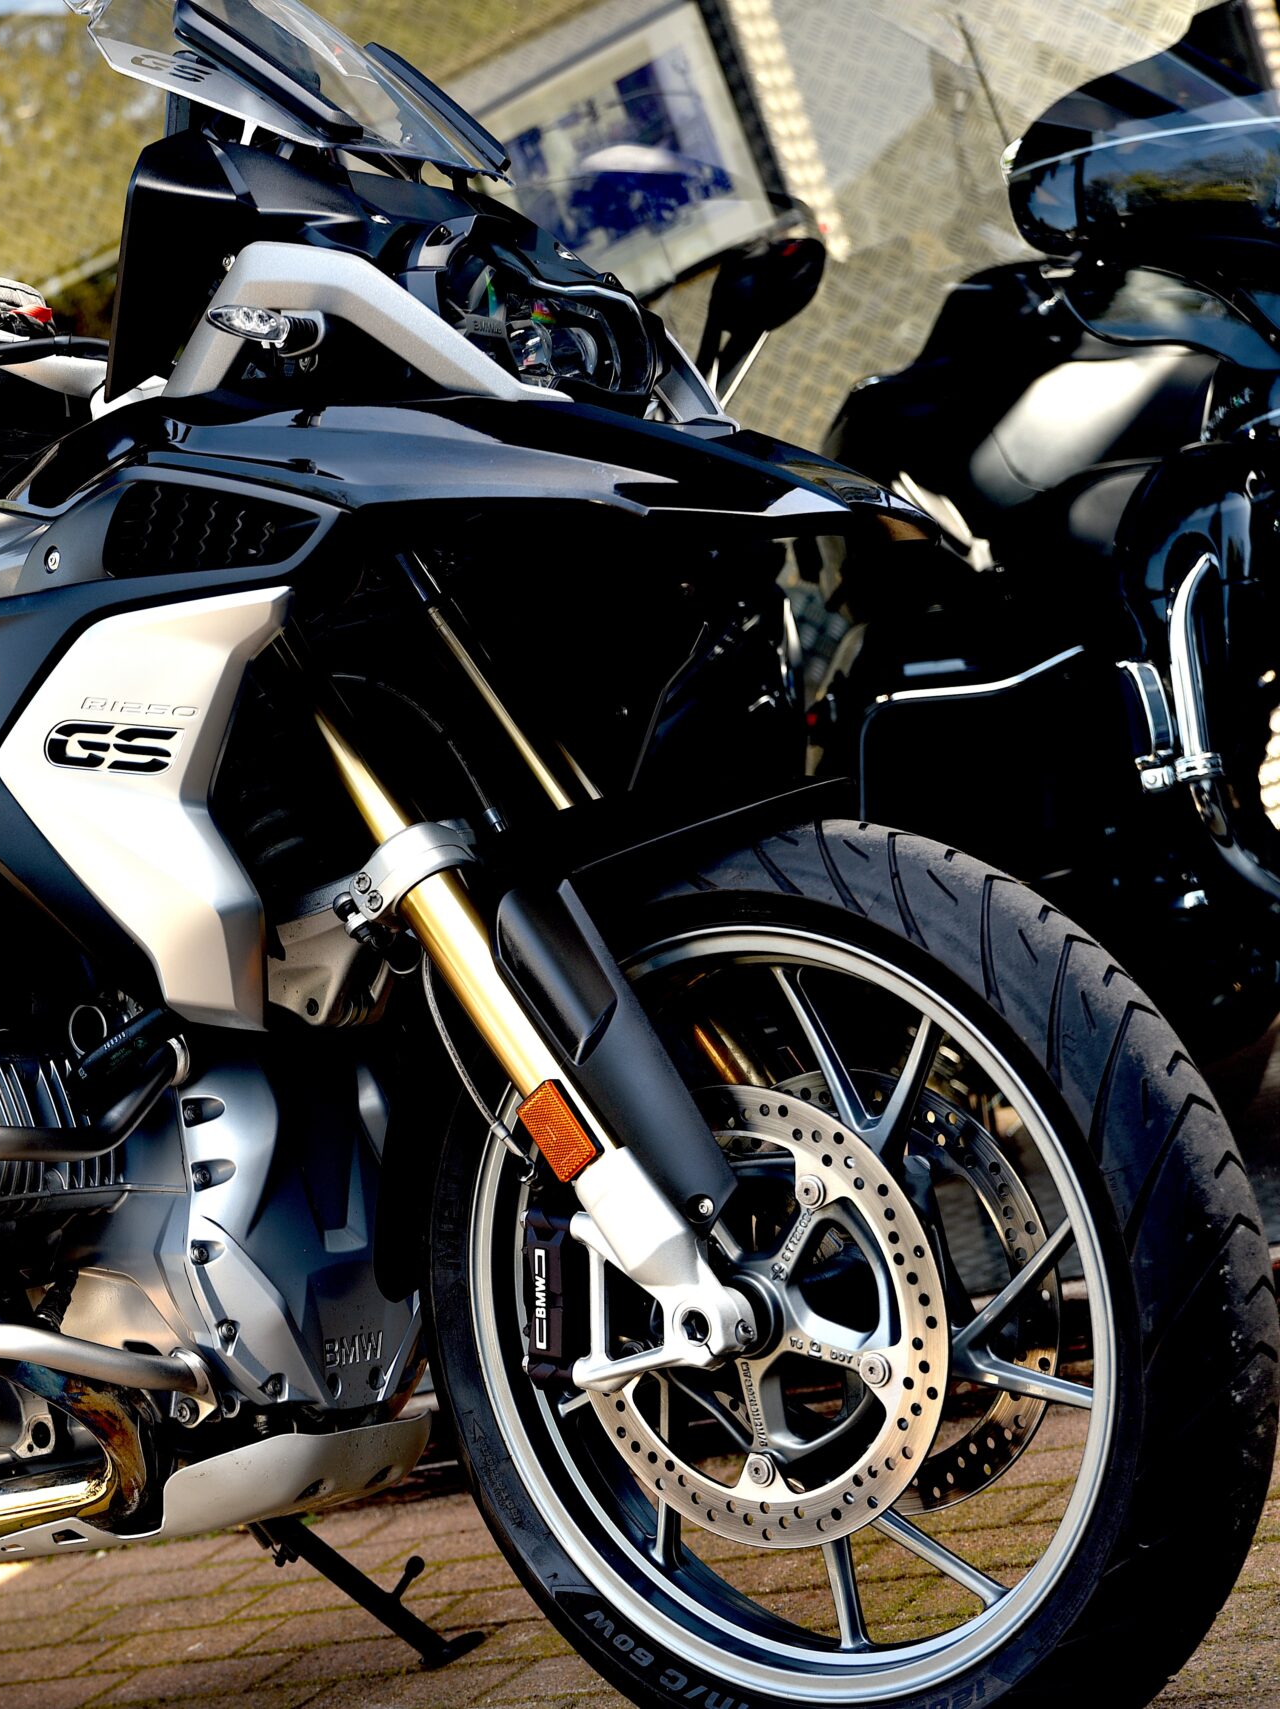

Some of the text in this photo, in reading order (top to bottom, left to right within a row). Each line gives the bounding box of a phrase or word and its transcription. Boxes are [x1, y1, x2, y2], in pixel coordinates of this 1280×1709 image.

[131, 54, 213, 82] GS
[81, 696, 200, 719] R1250
[47, 724, 179, 774] GS
[324, 1330, 383, 1369] BMW
[584, 1609, 655, 1668] 60W
